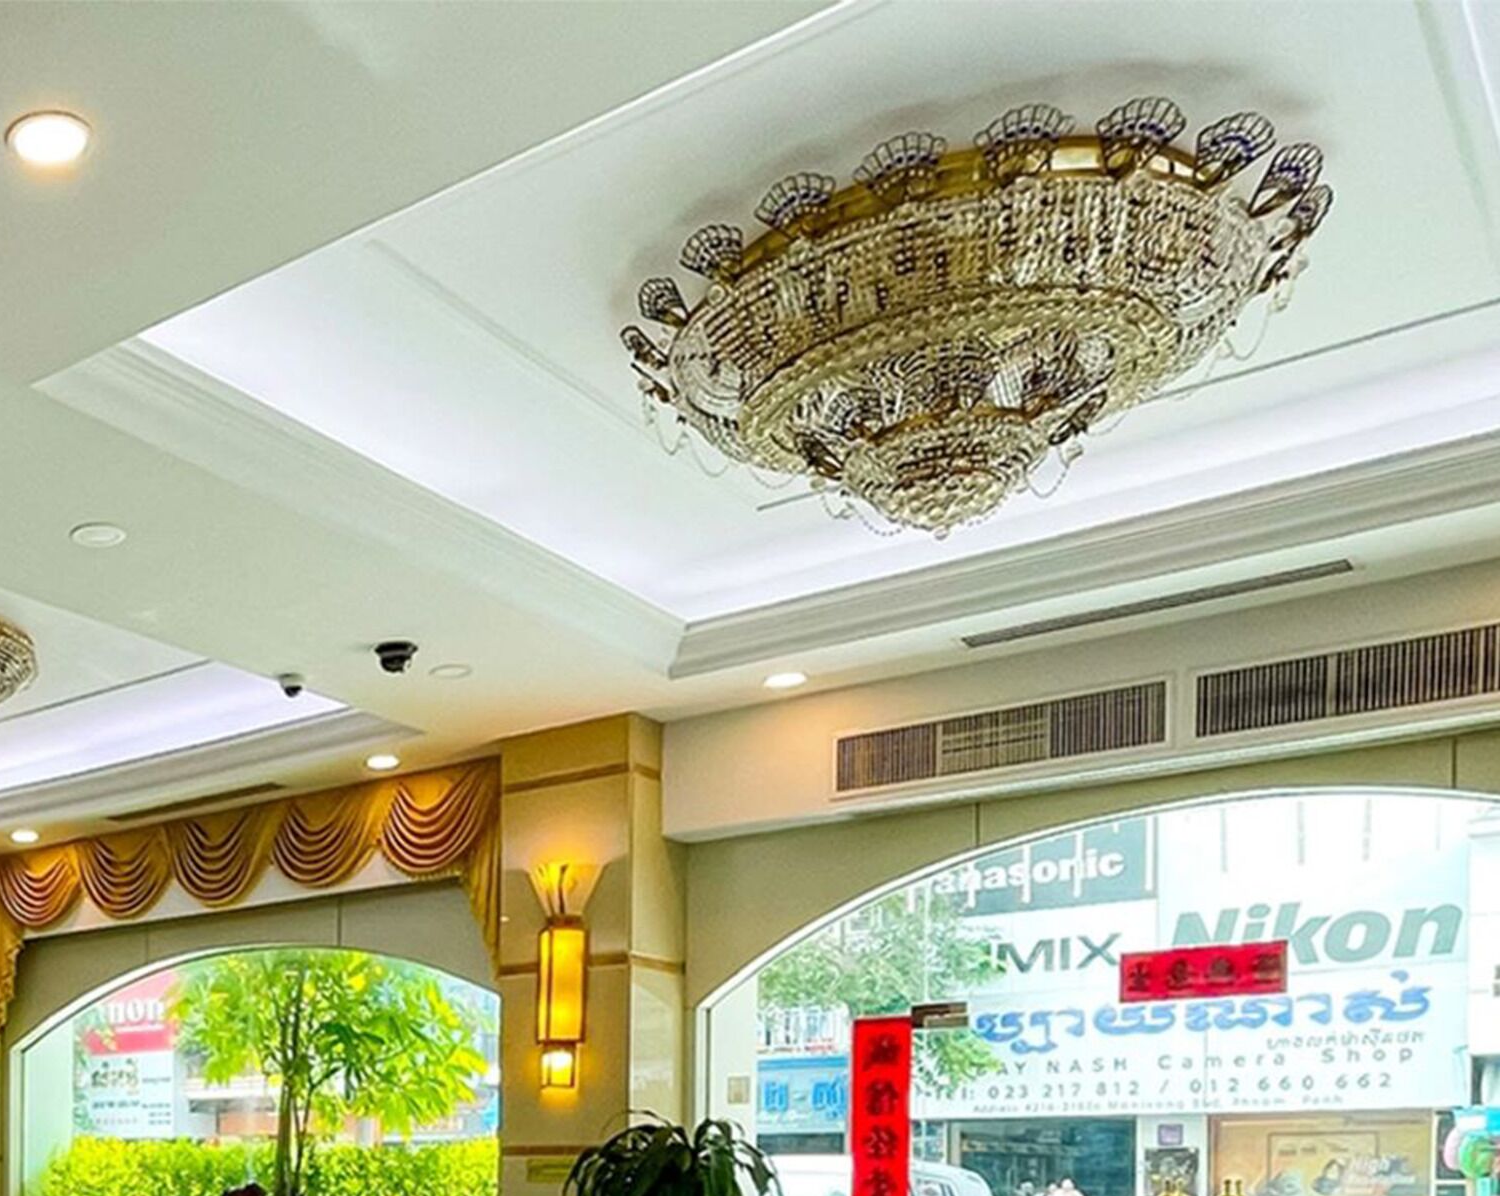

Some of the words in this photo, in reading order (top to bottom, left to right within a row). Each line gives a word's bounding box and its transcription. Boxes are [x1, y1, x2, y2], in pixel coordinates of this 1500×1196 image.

[933, 848, 1125, 895] anasonic
[996, 932, 1122, 974] MIX
[1171, 902, 1463, 965] Nikon
[1046, 1056, 1128, 1076] NASH
[1157, 1052, 1286, 1070] Camera
[1321, 1046, 1414, 1064] Shop
[987, 1085, 1029, 1100] 023
[1042, 1083, 1082, 1098] 217
[1096, 1081, 1140, 1097] 812
[1189, 1077, 1240, 1094] 012
[1257, 1074, 1315, 1091] 660
[1335, 1072, 1392, 1089] 662
